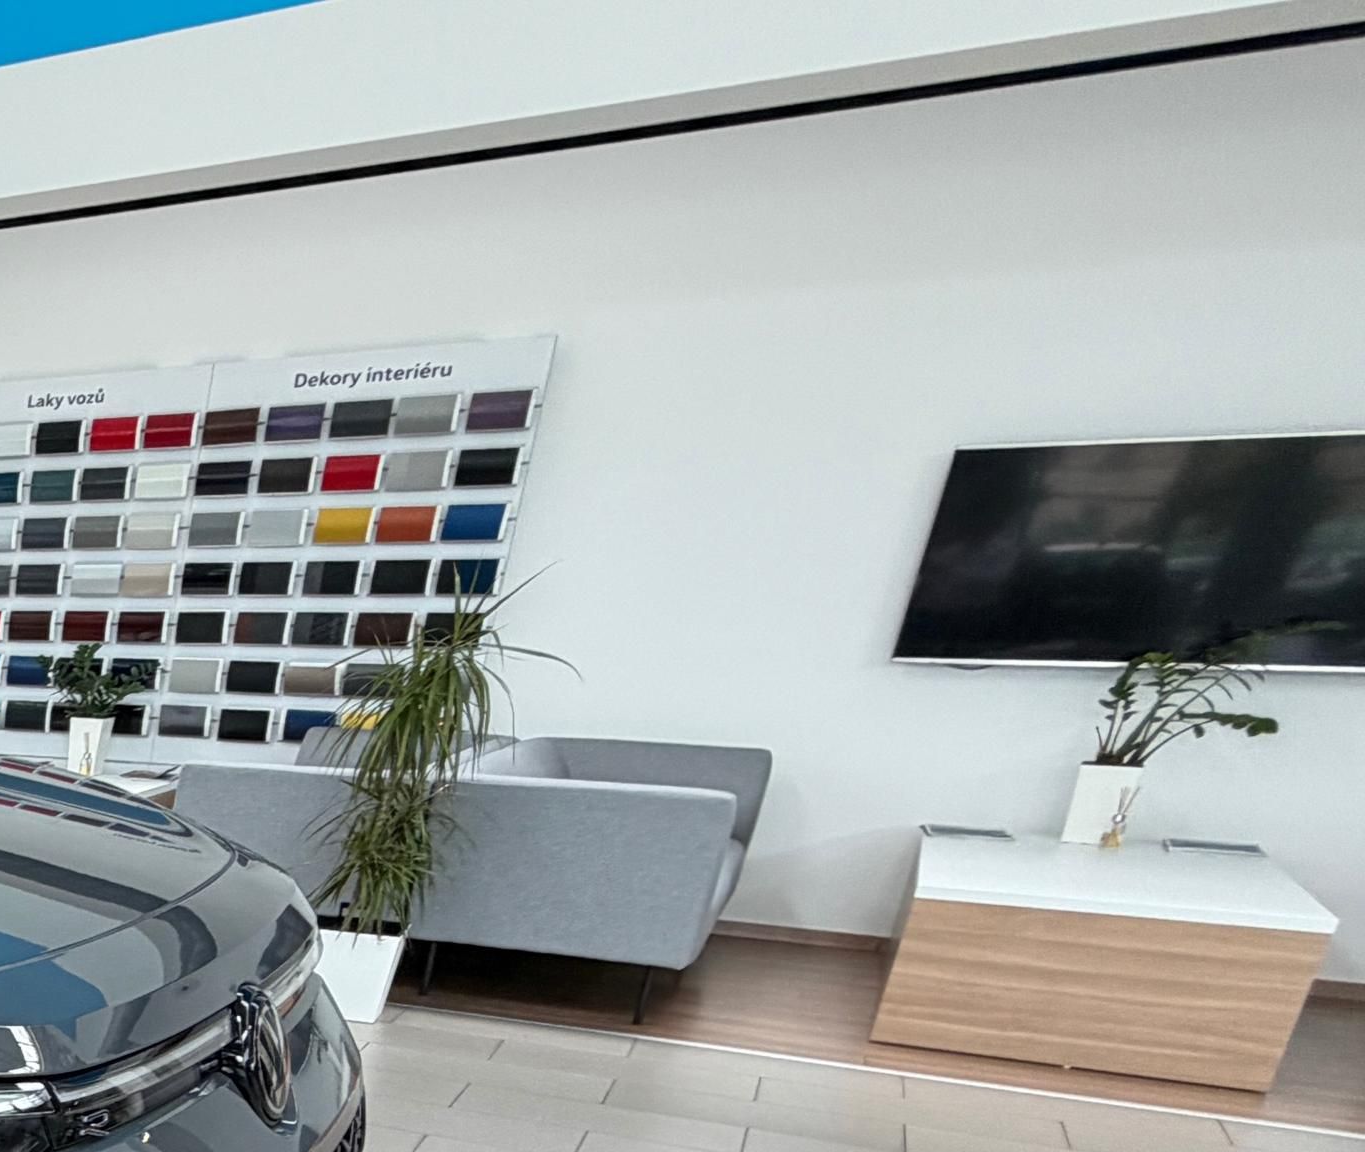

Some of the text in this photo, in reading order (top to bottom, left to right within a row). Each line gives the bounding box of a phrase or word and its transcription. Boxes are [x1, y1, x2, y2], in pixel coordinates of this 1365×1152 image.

[293, 363, 453, 389] Dekory interiéru
[27, 388, 105, 409] Laky vozů
